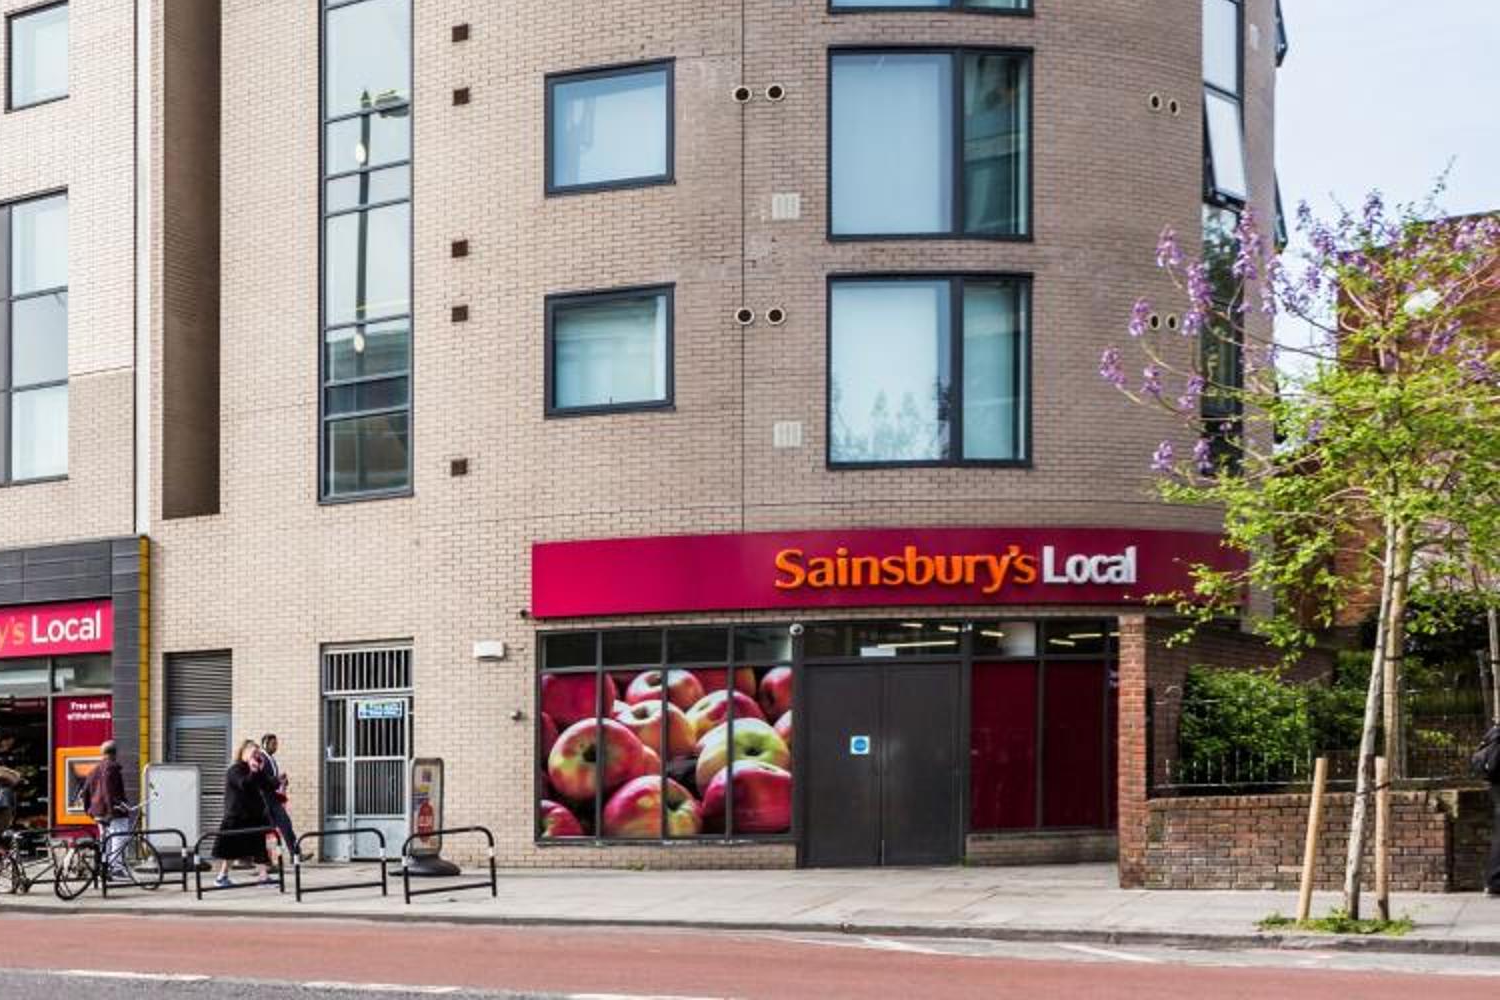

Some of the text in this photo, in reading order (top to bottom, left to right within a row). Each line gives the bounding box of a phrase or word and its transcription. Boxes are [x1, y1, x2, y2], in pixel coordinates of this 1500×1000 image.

[774, 545, 1137, 594] Sainsbury's Local
[31, 609, 102, 645] Local
